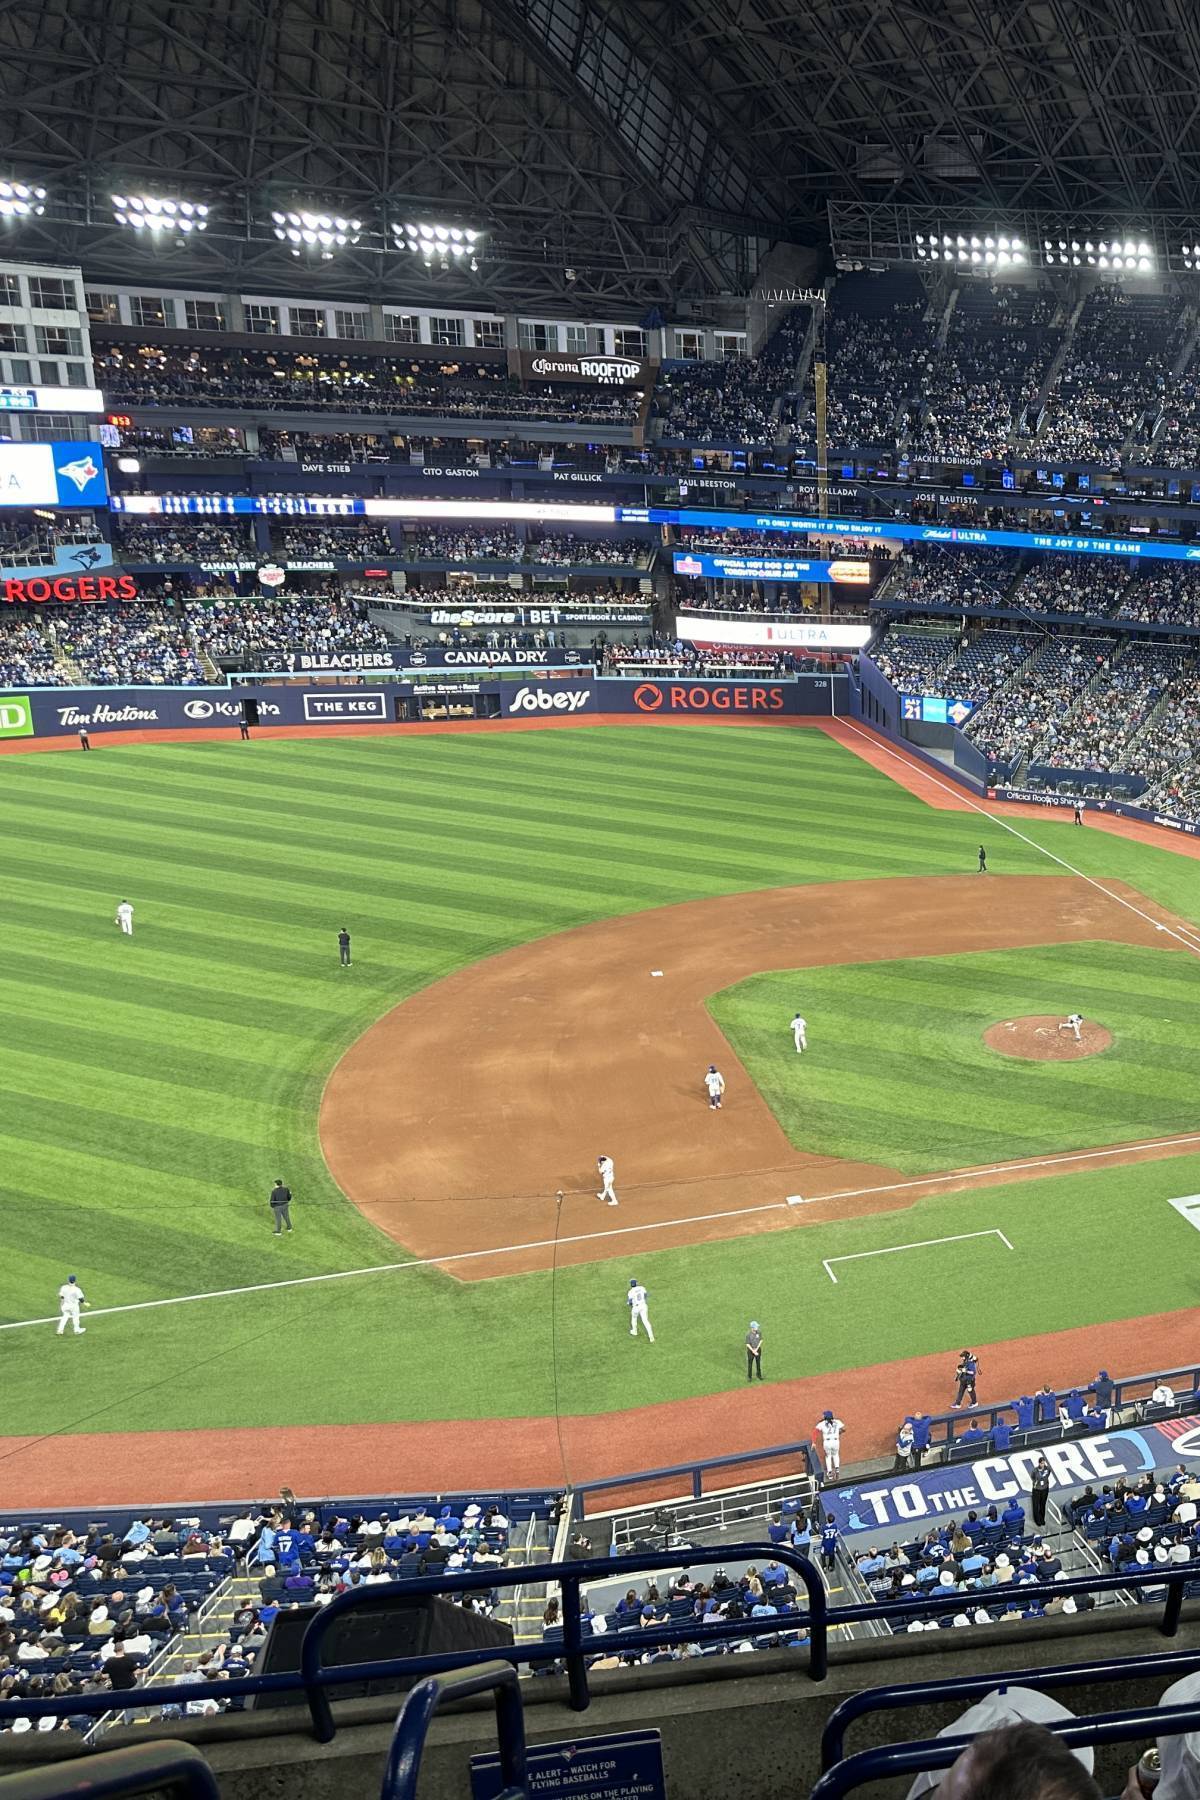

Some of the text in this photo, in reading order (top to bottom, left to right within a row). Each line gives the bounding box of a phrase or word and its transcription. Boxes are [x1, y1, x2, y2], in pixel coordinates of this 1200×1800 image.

[532, 358, 640, 378] Corona ROOFTOP
[598, 376, 624, 385] PATIO
[913, 454, 939, 463] JACKIE
[941, 457, 982, 465] ROBINSON
[302, 463, 351, 474] DAVE STIEB
[423, 467, 480, 477] CITO GASTON
[554, 473, 602, 482] PAT GILLICK
[678, 478, 736, 488] PAUL BEESTON
[799, 486, 815, 494] ROY
[817, 487, 858, 496] HALLADAY
[915, 493, 978, 504] JOSÉ BAUTISTA
[772, 519, 790, 527] ONLY
[791, 520, 817, 529] WORTH
[851, 524, 873, 533] ENJOY
[958, 531, 987, 541] ULTRA
[1034, 537, 1141, 552] THE JOY OF THE GAME
[200, 561, 256, 570] CANADA DRY
[286, 561, 334, 569] BLEACHERS
[713, 558, 746, 568] OFFICIAL
[723, 568, 758, 577] TORONTO
[5, 575, 138, 603] ROGERS
[431, 609, 515, 625] theScore
[530, 609, 561, 624] BET
[565, 613, 610, 622] SPORTSBOOK
[618, 614, 643, 622] CASINO
[777, 629, 828, 641] ULTRA
[300, 652, 393, 669] BLEACHERS
[444, 651, 508, 664] CANADA
[814, 680, 827, 688] 328
[509, 687, 590, 713] Sobeys
[671, 686, 784, 709] ROGERS
[314, 701, 377, 712] THE KEG
[904, 704, 920, 719] 21
[57, 704, 159, 726] Tim Hortons
[1006, 791, 1031, 801] Official
[1032, 794, 1059, 805] Roofing
[1185, 823, 1197, 832] BET
[860, 1435, 1128, 1525] TO THE CORE
[278, 1540, 293, 1553] 17
[536, 1769, 561, 1780] ALERT
[570, 1763, 598, 1775] WATCH
[600, 1760, 616, 1769] FOR
[531, 1770, 609, 1790] FLYING BASEBALLS
[591, 1791, 602, 1800] ON
[604, 1789, 619, 1798] THE
[621, 1784, 654, 1796] PLAYING
